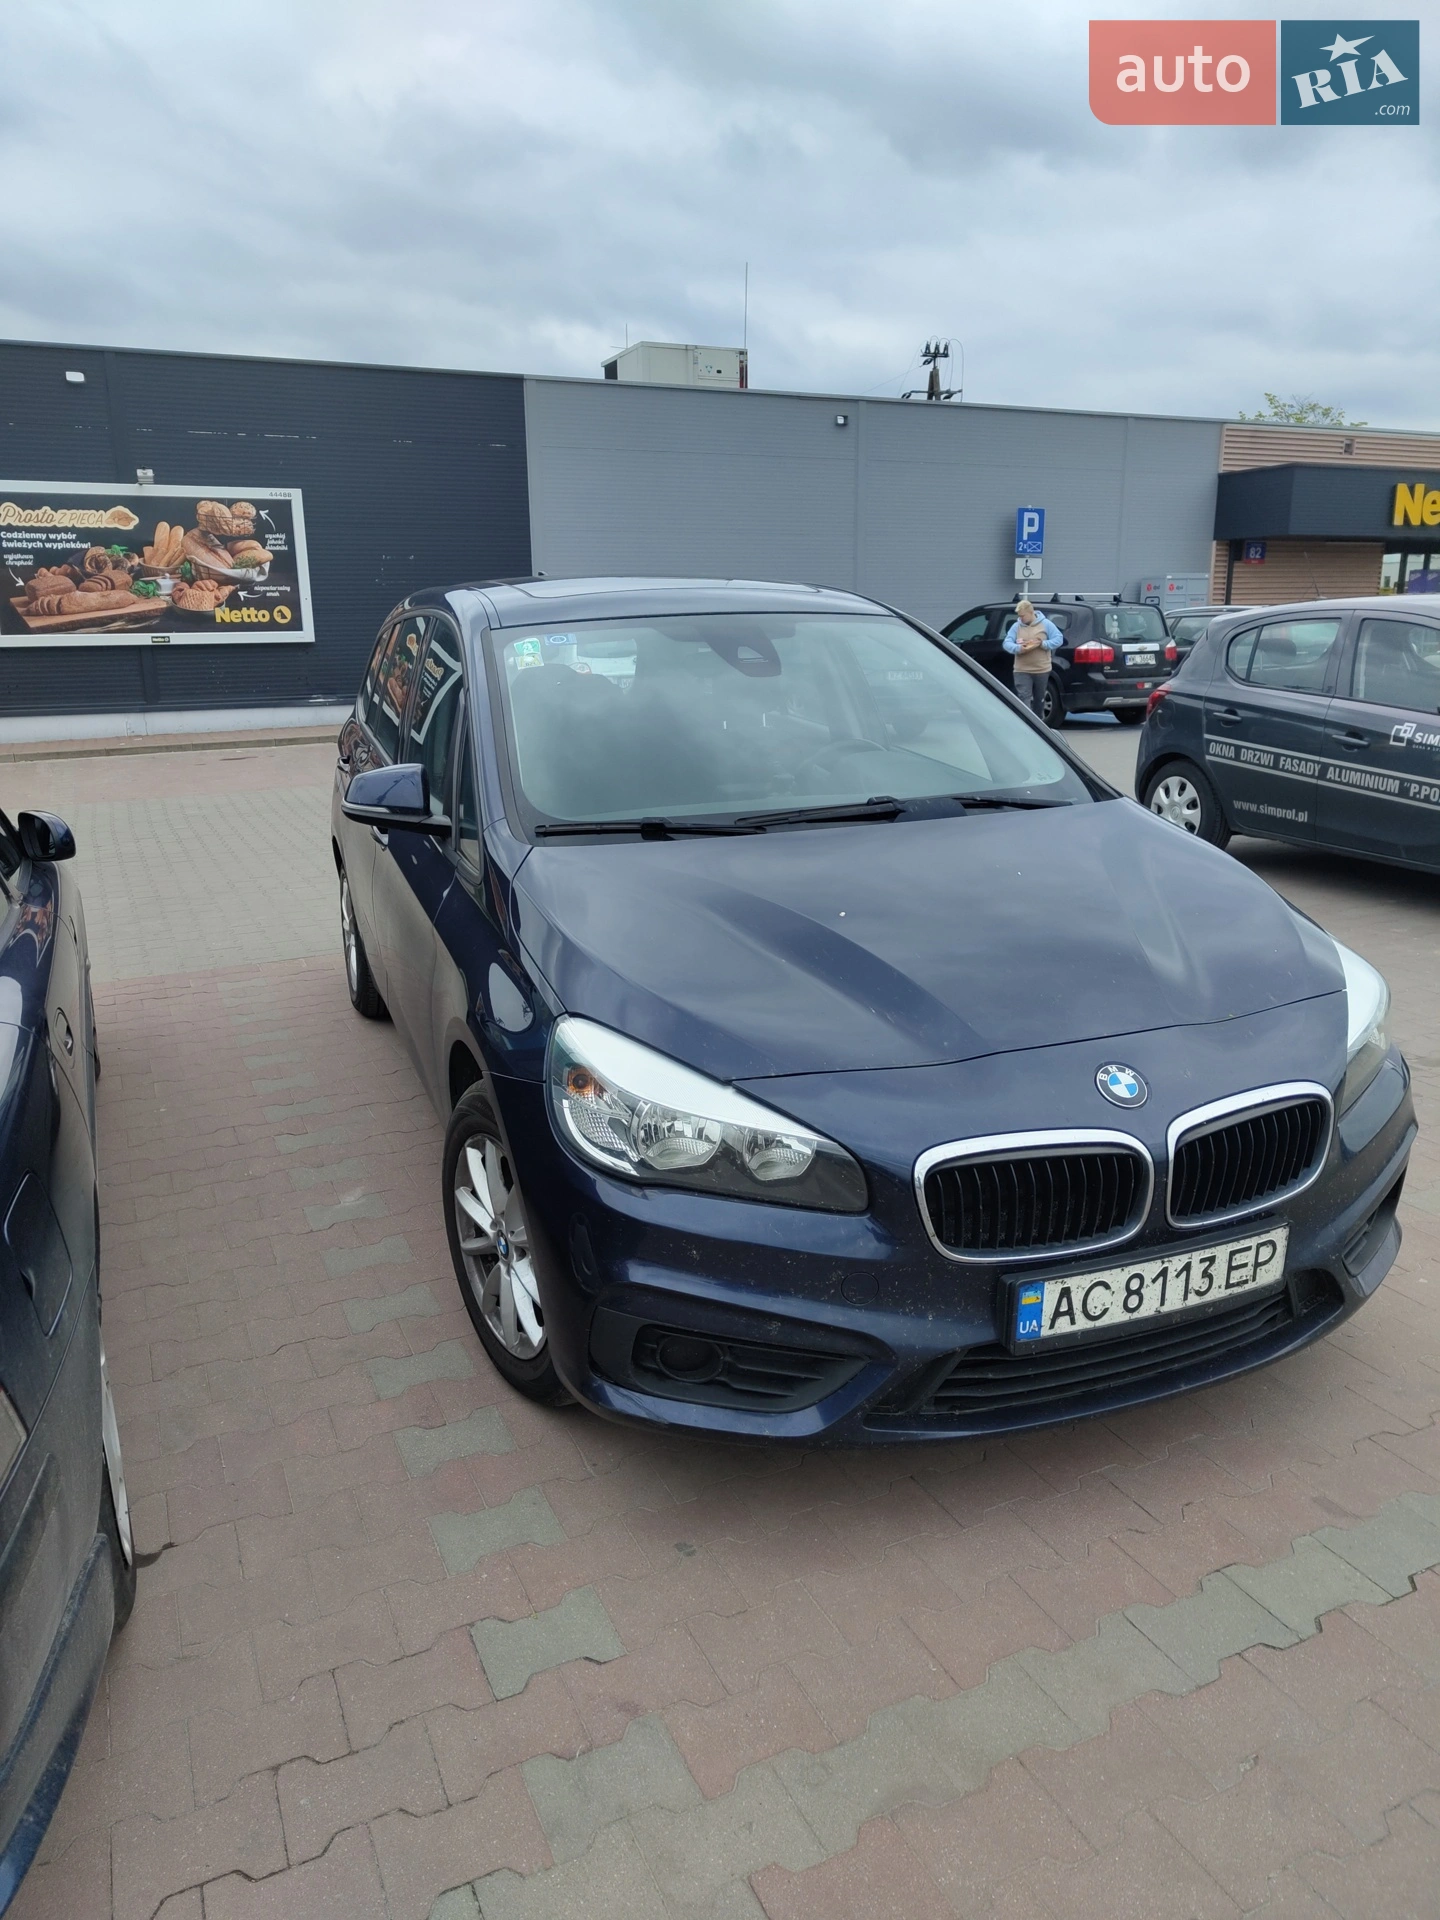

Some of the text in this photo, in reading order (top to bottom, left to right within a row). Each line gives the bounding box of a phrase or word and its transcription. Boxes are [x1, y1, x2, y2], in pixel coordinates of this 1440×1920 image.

[2, 505, 56, 524] Prosto
[68, 512, 104, 525] PIECA
[1023, 511, 1040, 541] P
[0, 531, 77, 541] Codzienny wybór
[2, 540, 91, 550] świeżych wypieków!
[1250, 547, 1262, 559] 82
[214, 607, 270, 623] Netto
[1209, 742, 1235, 759] OKNA
[1240, 748, 1274, 767] DRZWI
[1279, 756, 1322, 777] FASADY
[1327, 766, 1400, 794] ALUMINIUM
[1048, 1238, 1278, 1330] AC 8113 EP
[1019, 1318, 1040, 1335] UA
